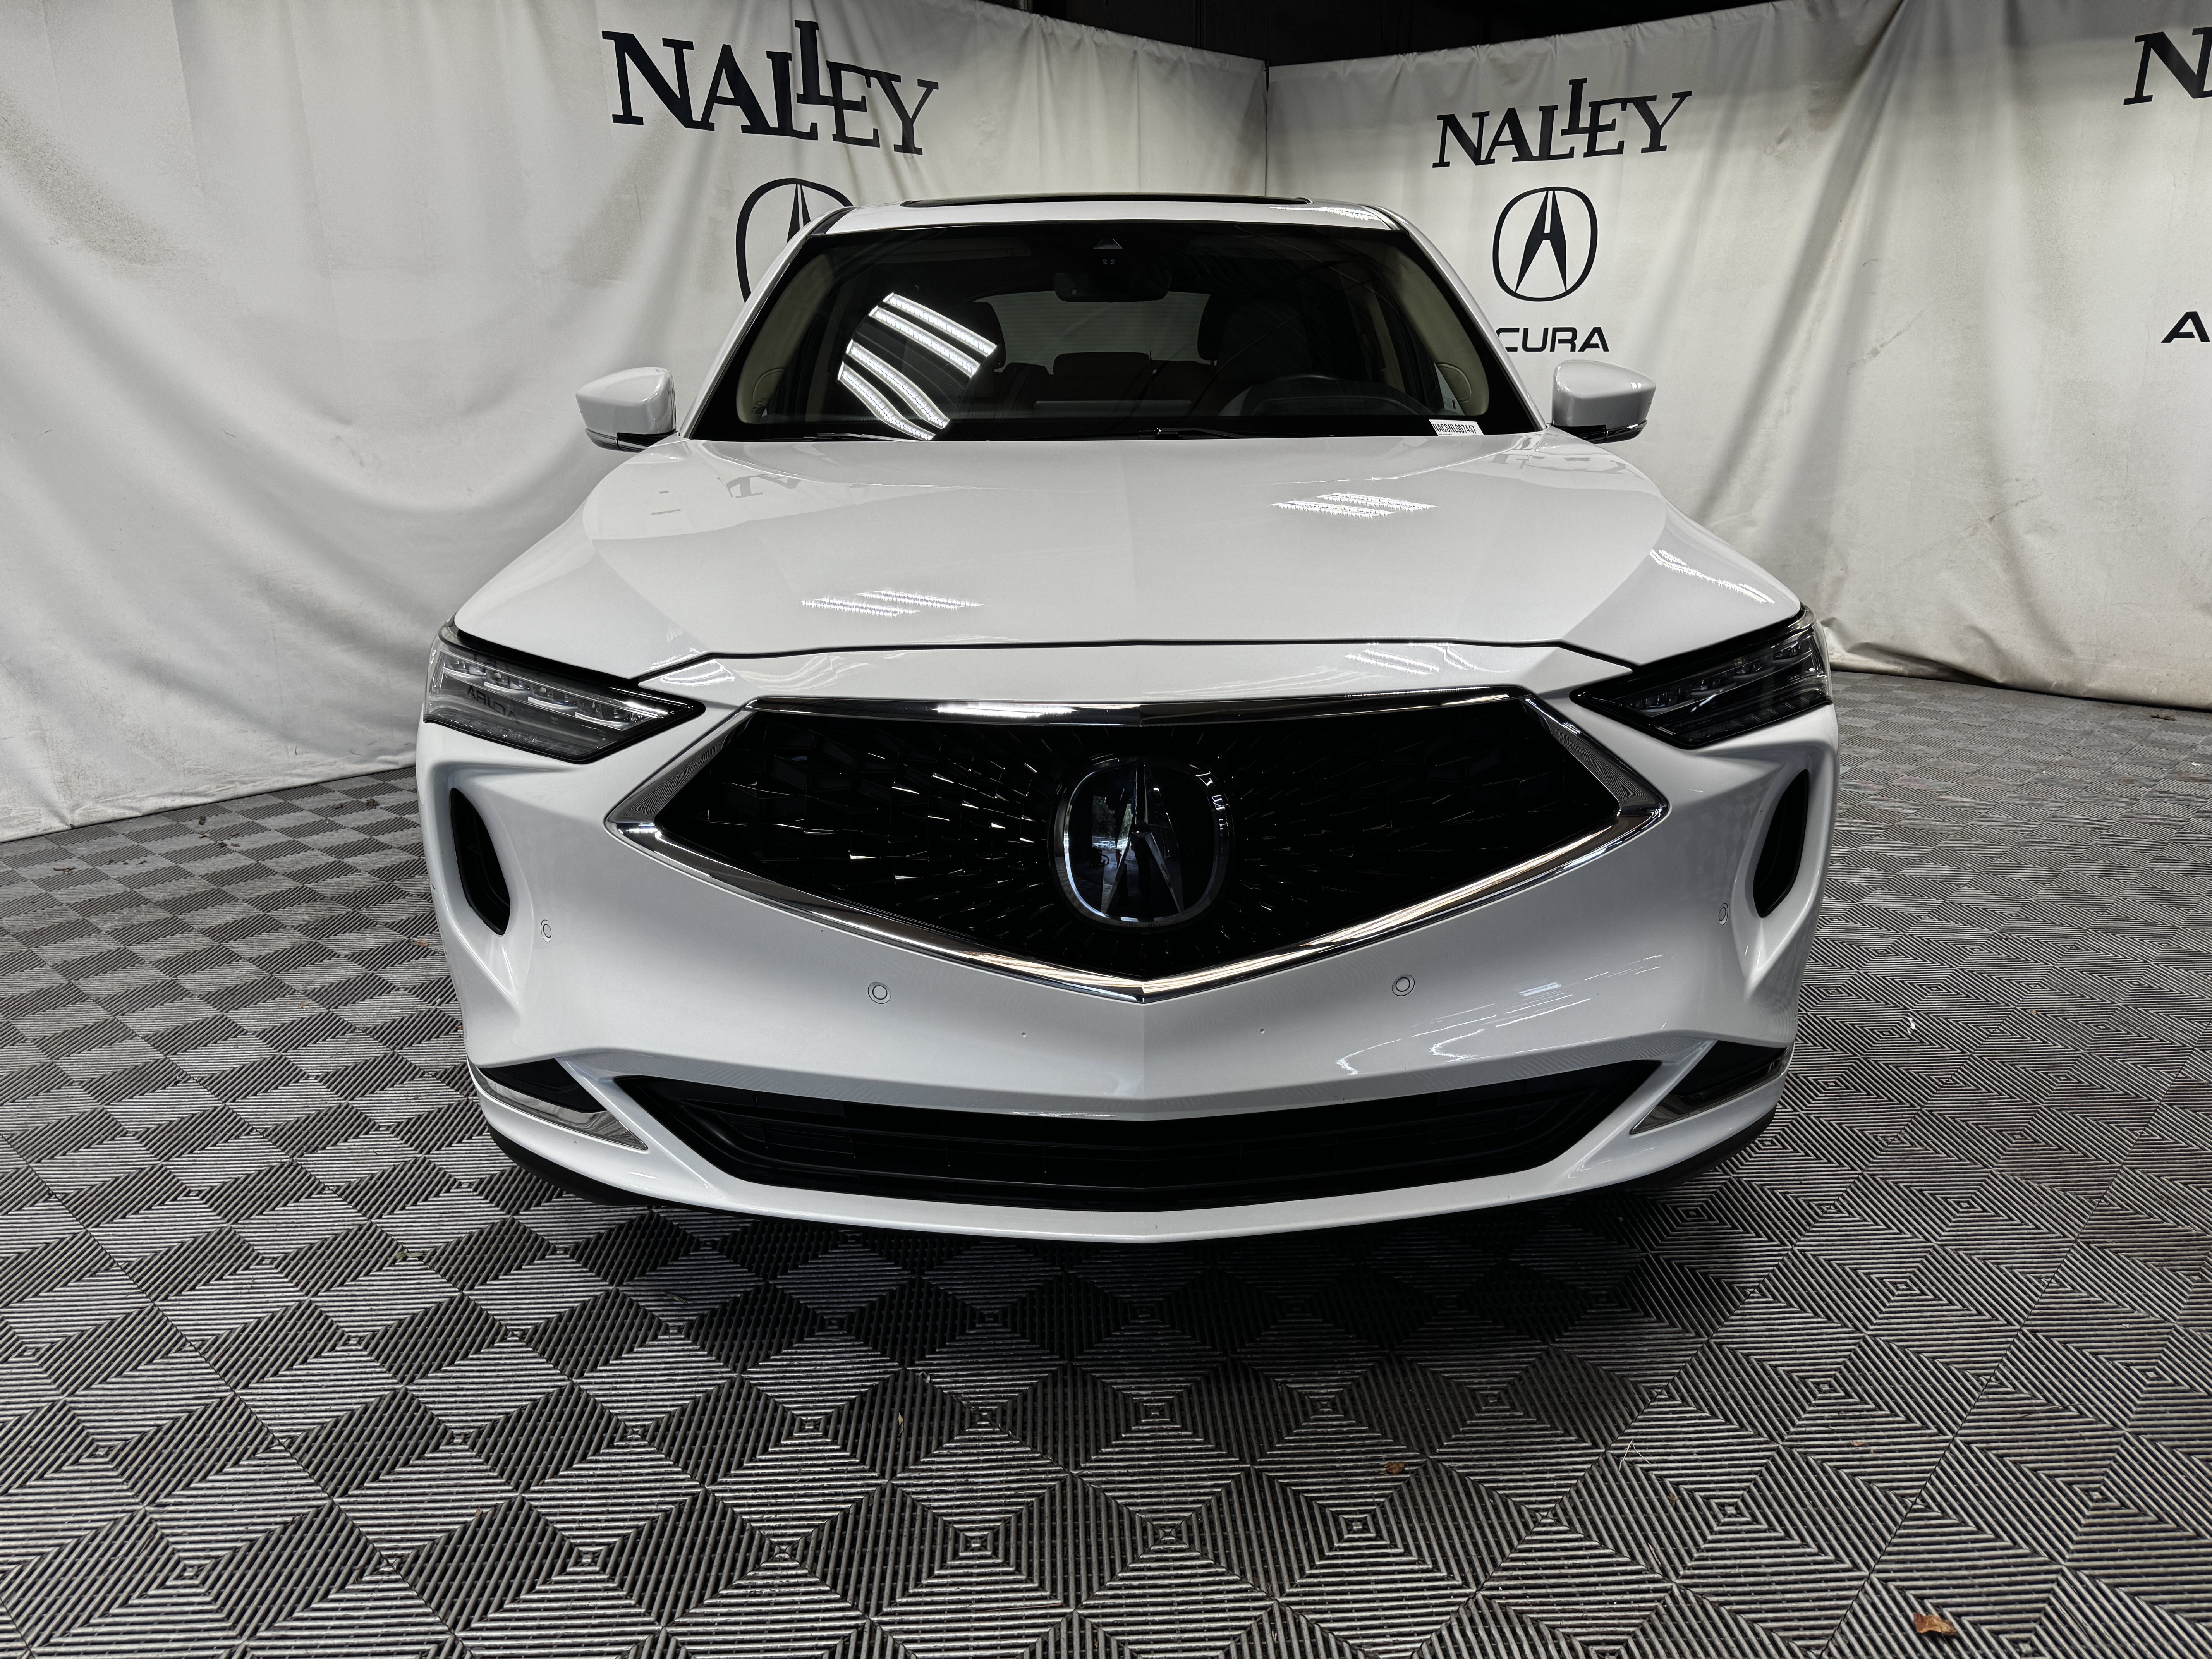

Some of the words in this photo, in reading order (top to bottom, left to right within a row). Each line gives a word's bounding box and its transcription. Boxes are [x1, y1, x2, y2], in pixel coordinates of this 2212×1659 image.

[601, 19, 939, 155] NALLEY
[1432, 77, 1692, 168] NALLEY
[1496, 327, 1609, 352] CURA
